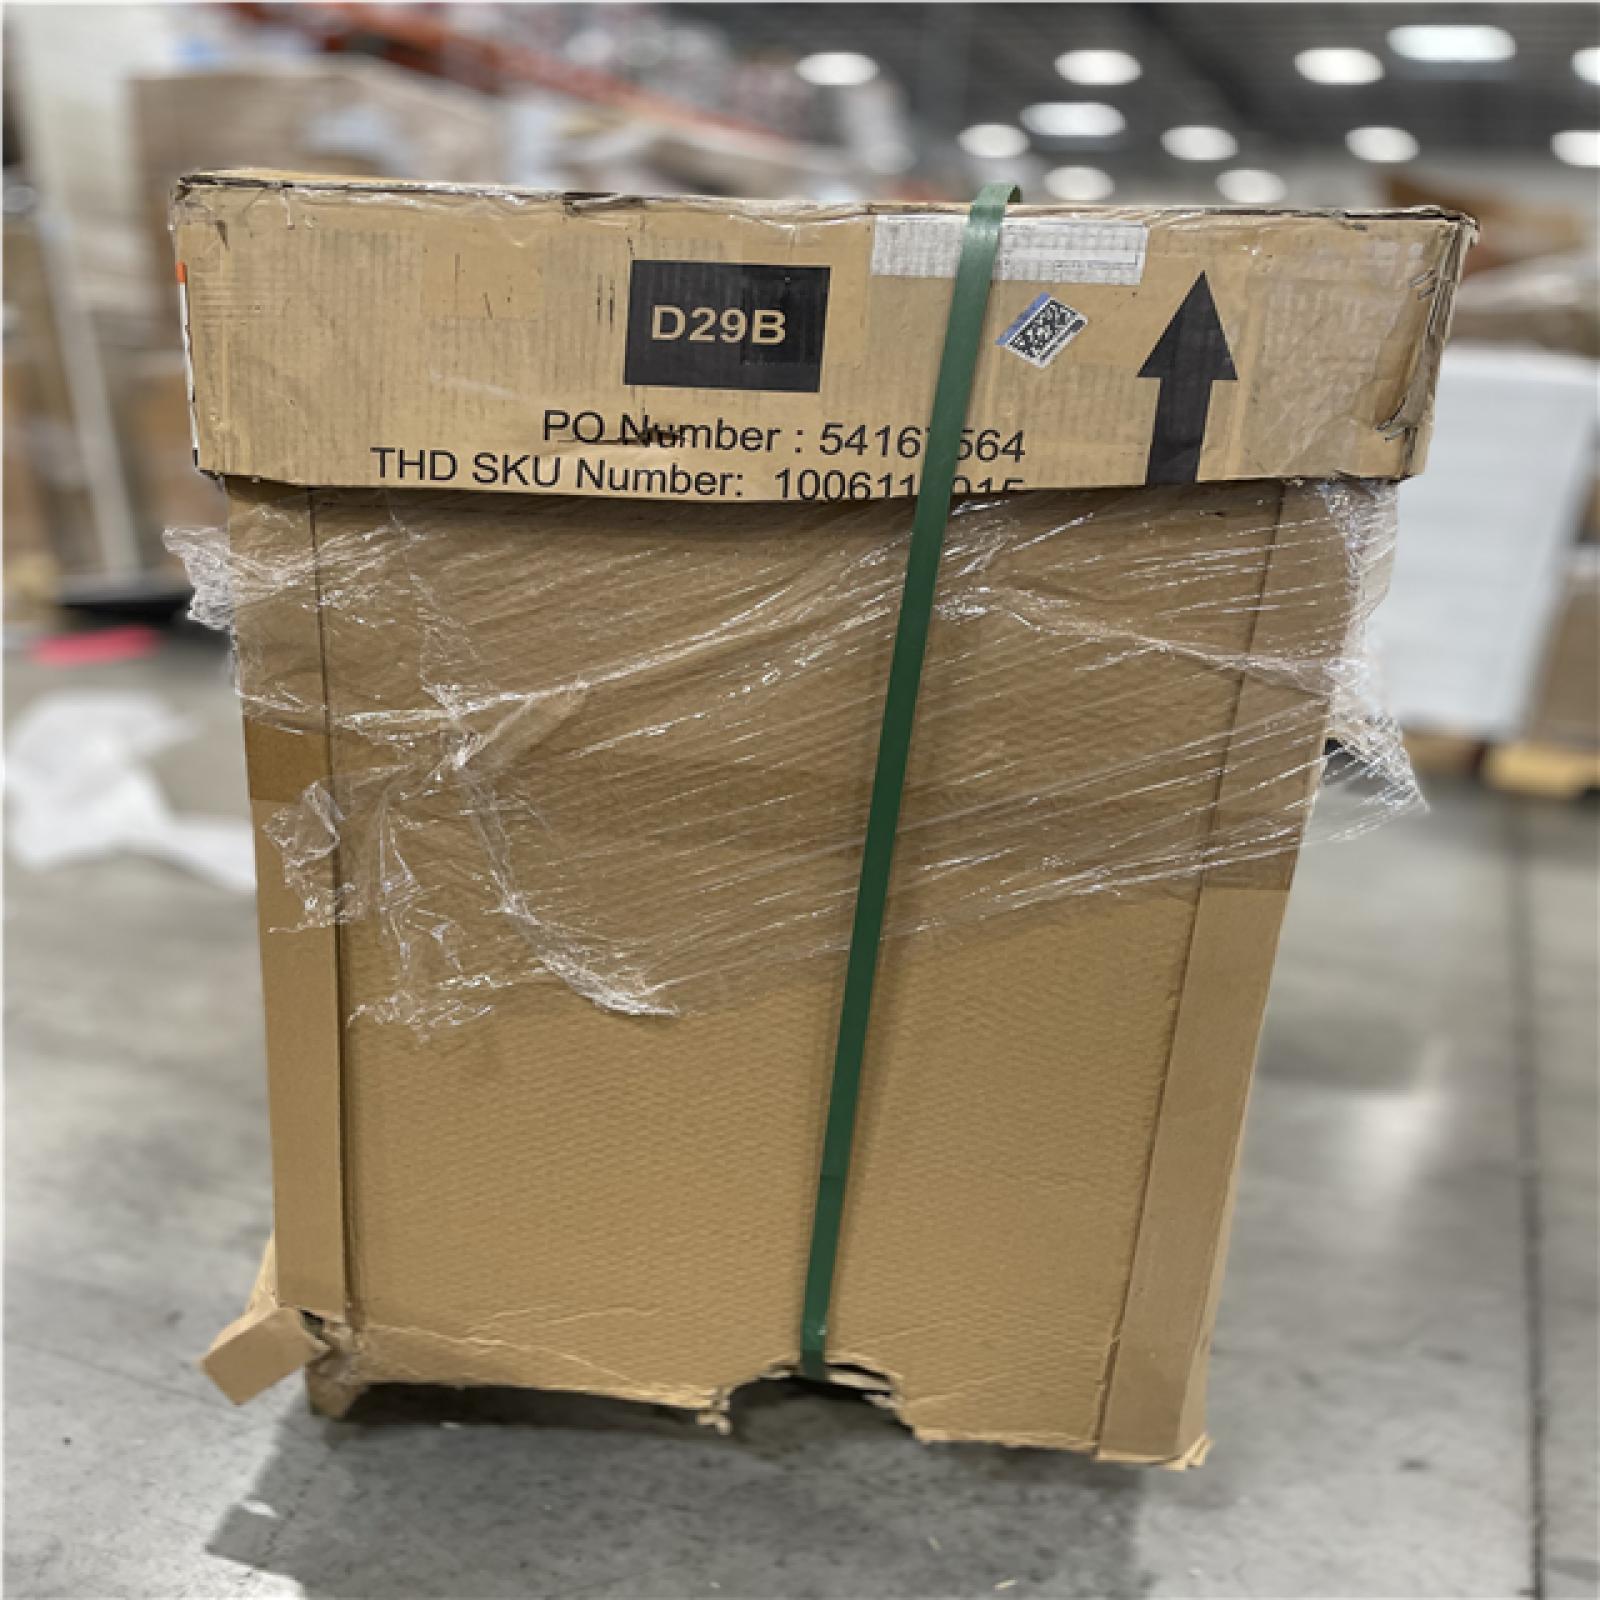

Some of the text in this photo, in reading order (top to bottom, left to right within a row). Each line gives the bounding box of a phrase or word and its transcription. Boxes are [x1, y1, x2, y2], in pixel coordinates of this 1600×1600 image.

[651, 304, 786, 345] D29B
[544, 410, 605, 443] PO
[621, 413, 781, 453] Number
[820, 422, 1026, 462] 5416564
[370, 447, 457, 481] THD
[472, 452, 560, 487] SKU
[576, 457, 743, 498] Number:
